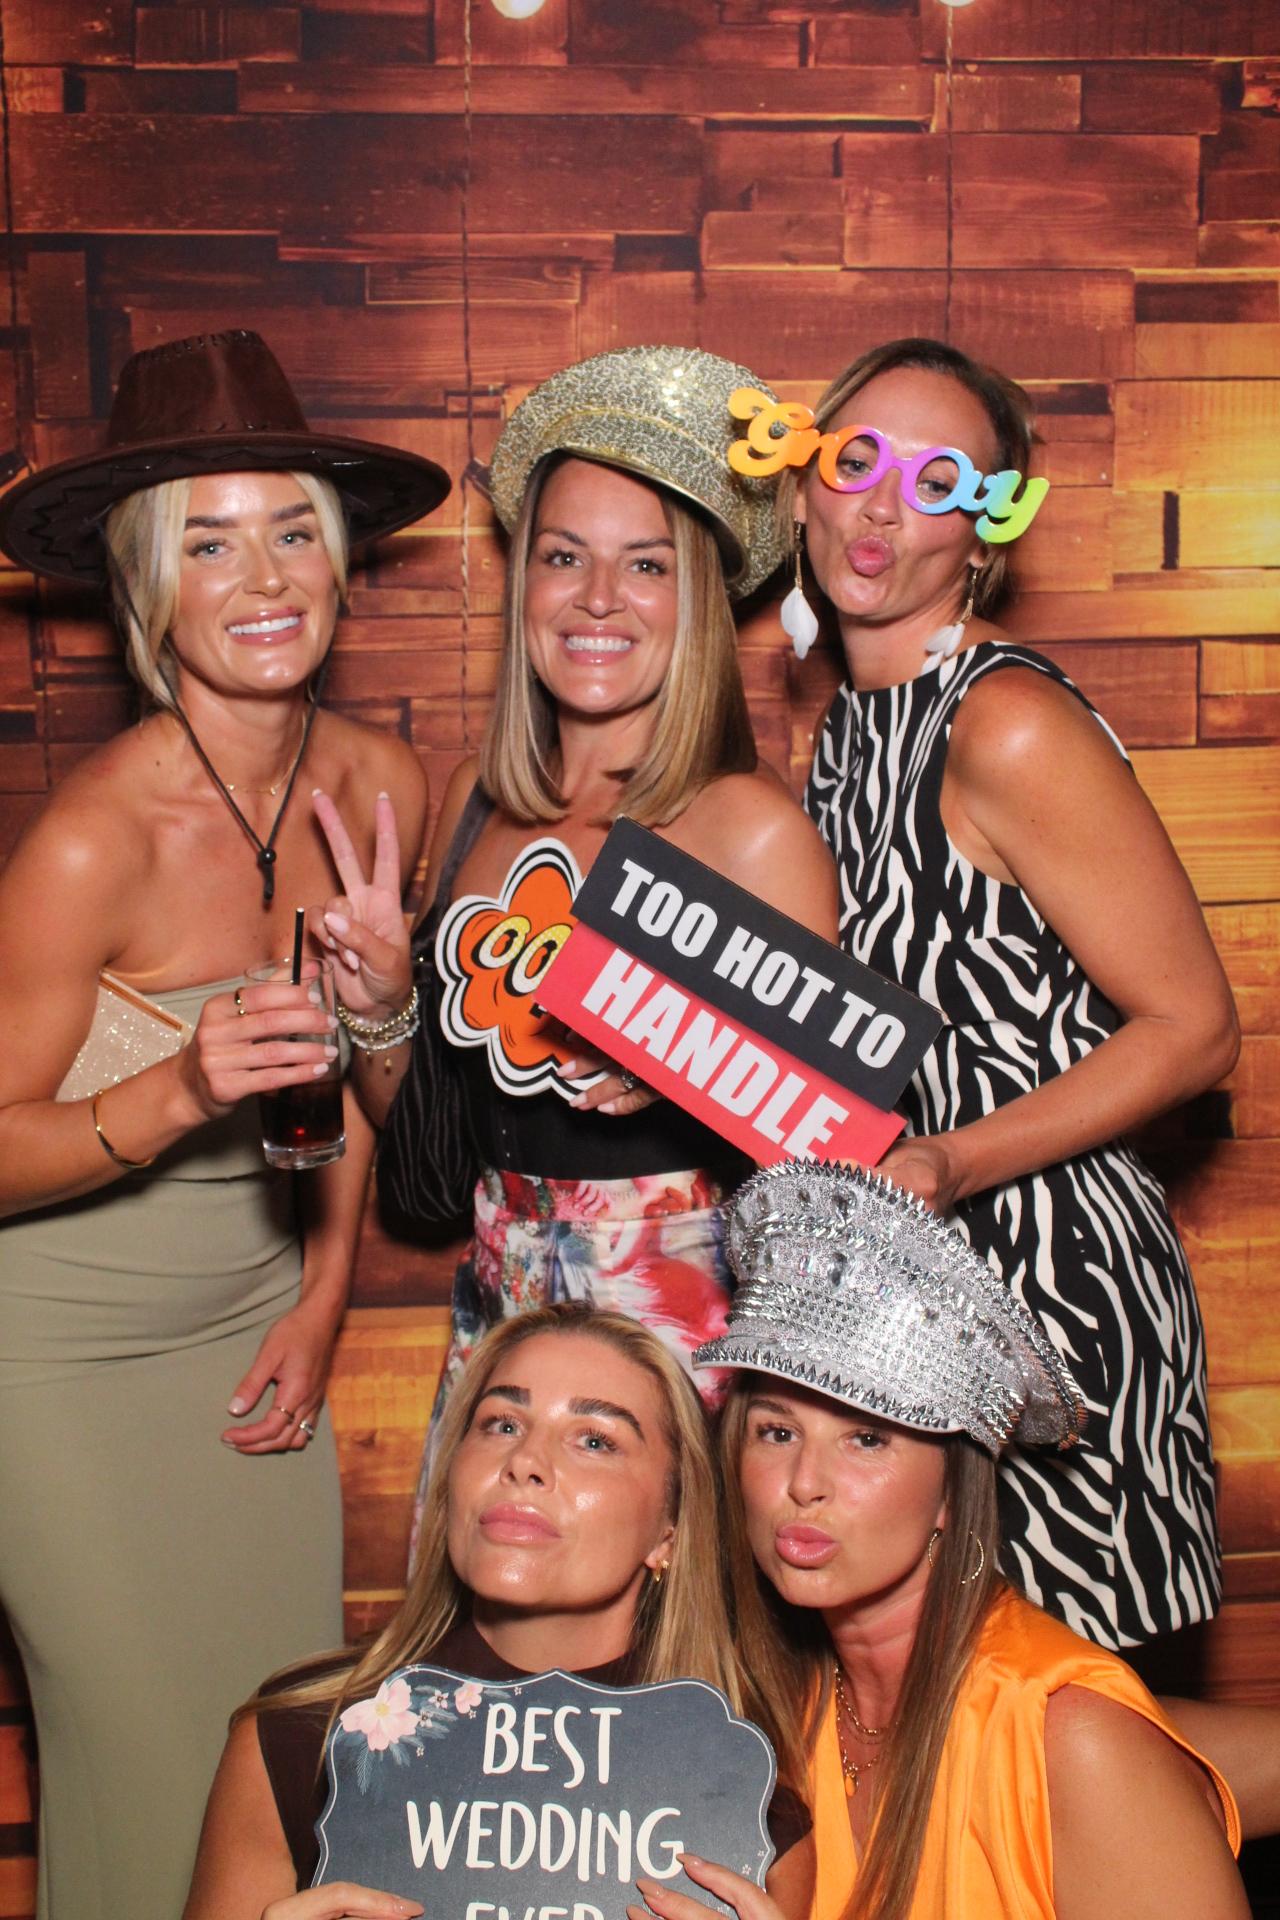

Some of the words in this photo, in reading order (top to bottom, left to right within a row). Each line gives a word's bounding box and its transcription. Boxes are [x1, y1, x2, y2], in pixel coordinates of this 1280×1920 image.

[611, 858, 718, 958] TOO
[712, 926, 835, 1025] HOT
[828, 991, 907, 1069] TO
[580, 948, 849, 1159] HANDLE
[483, 1703, 622, 1789] BEST
[406, 1801, 684, 1883] WEDDING
